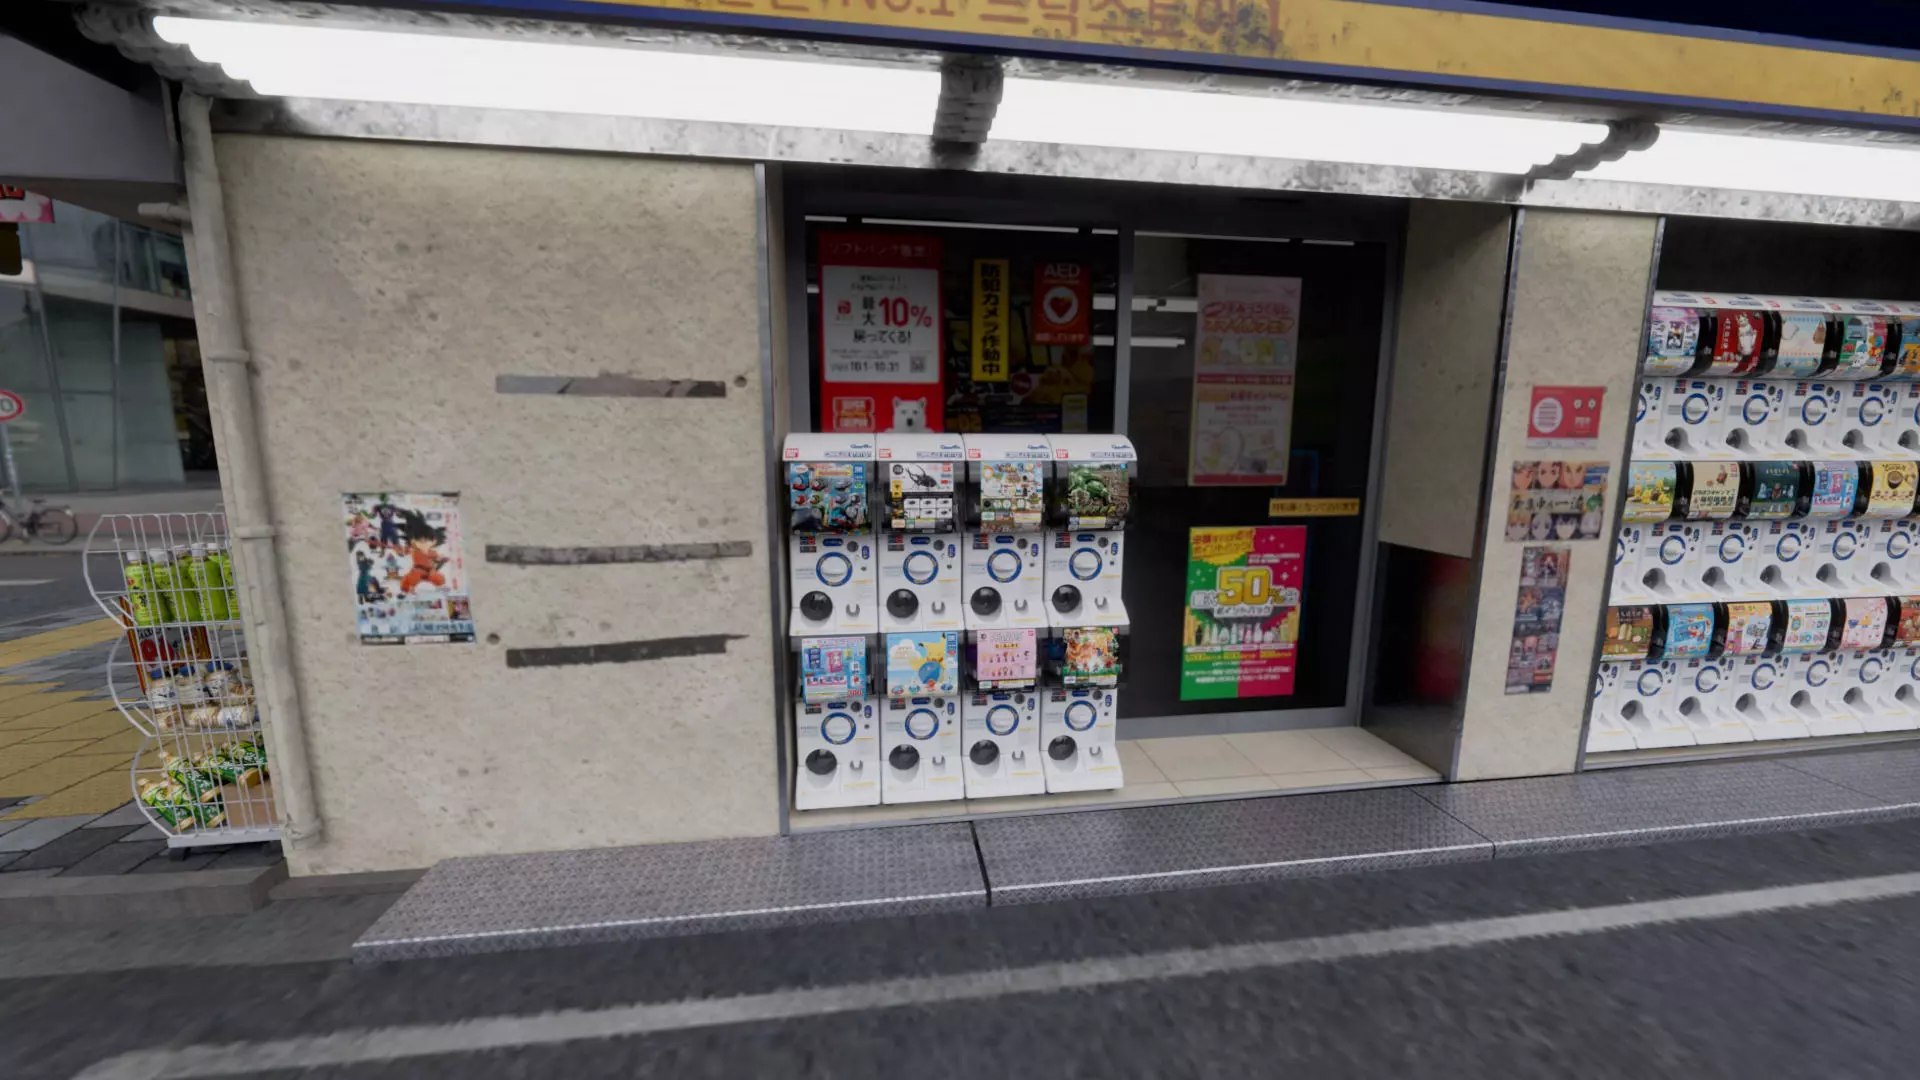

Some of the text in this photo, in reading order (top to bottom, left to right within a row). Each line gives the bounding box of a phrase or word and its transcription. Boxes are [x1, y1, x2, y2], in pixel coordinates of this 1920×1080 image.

[1044, 263, 1081, 278] AED
[879, 297, 932, 327] 10%
[981, 263, 1001, 376] 防犯カメラ作動中
